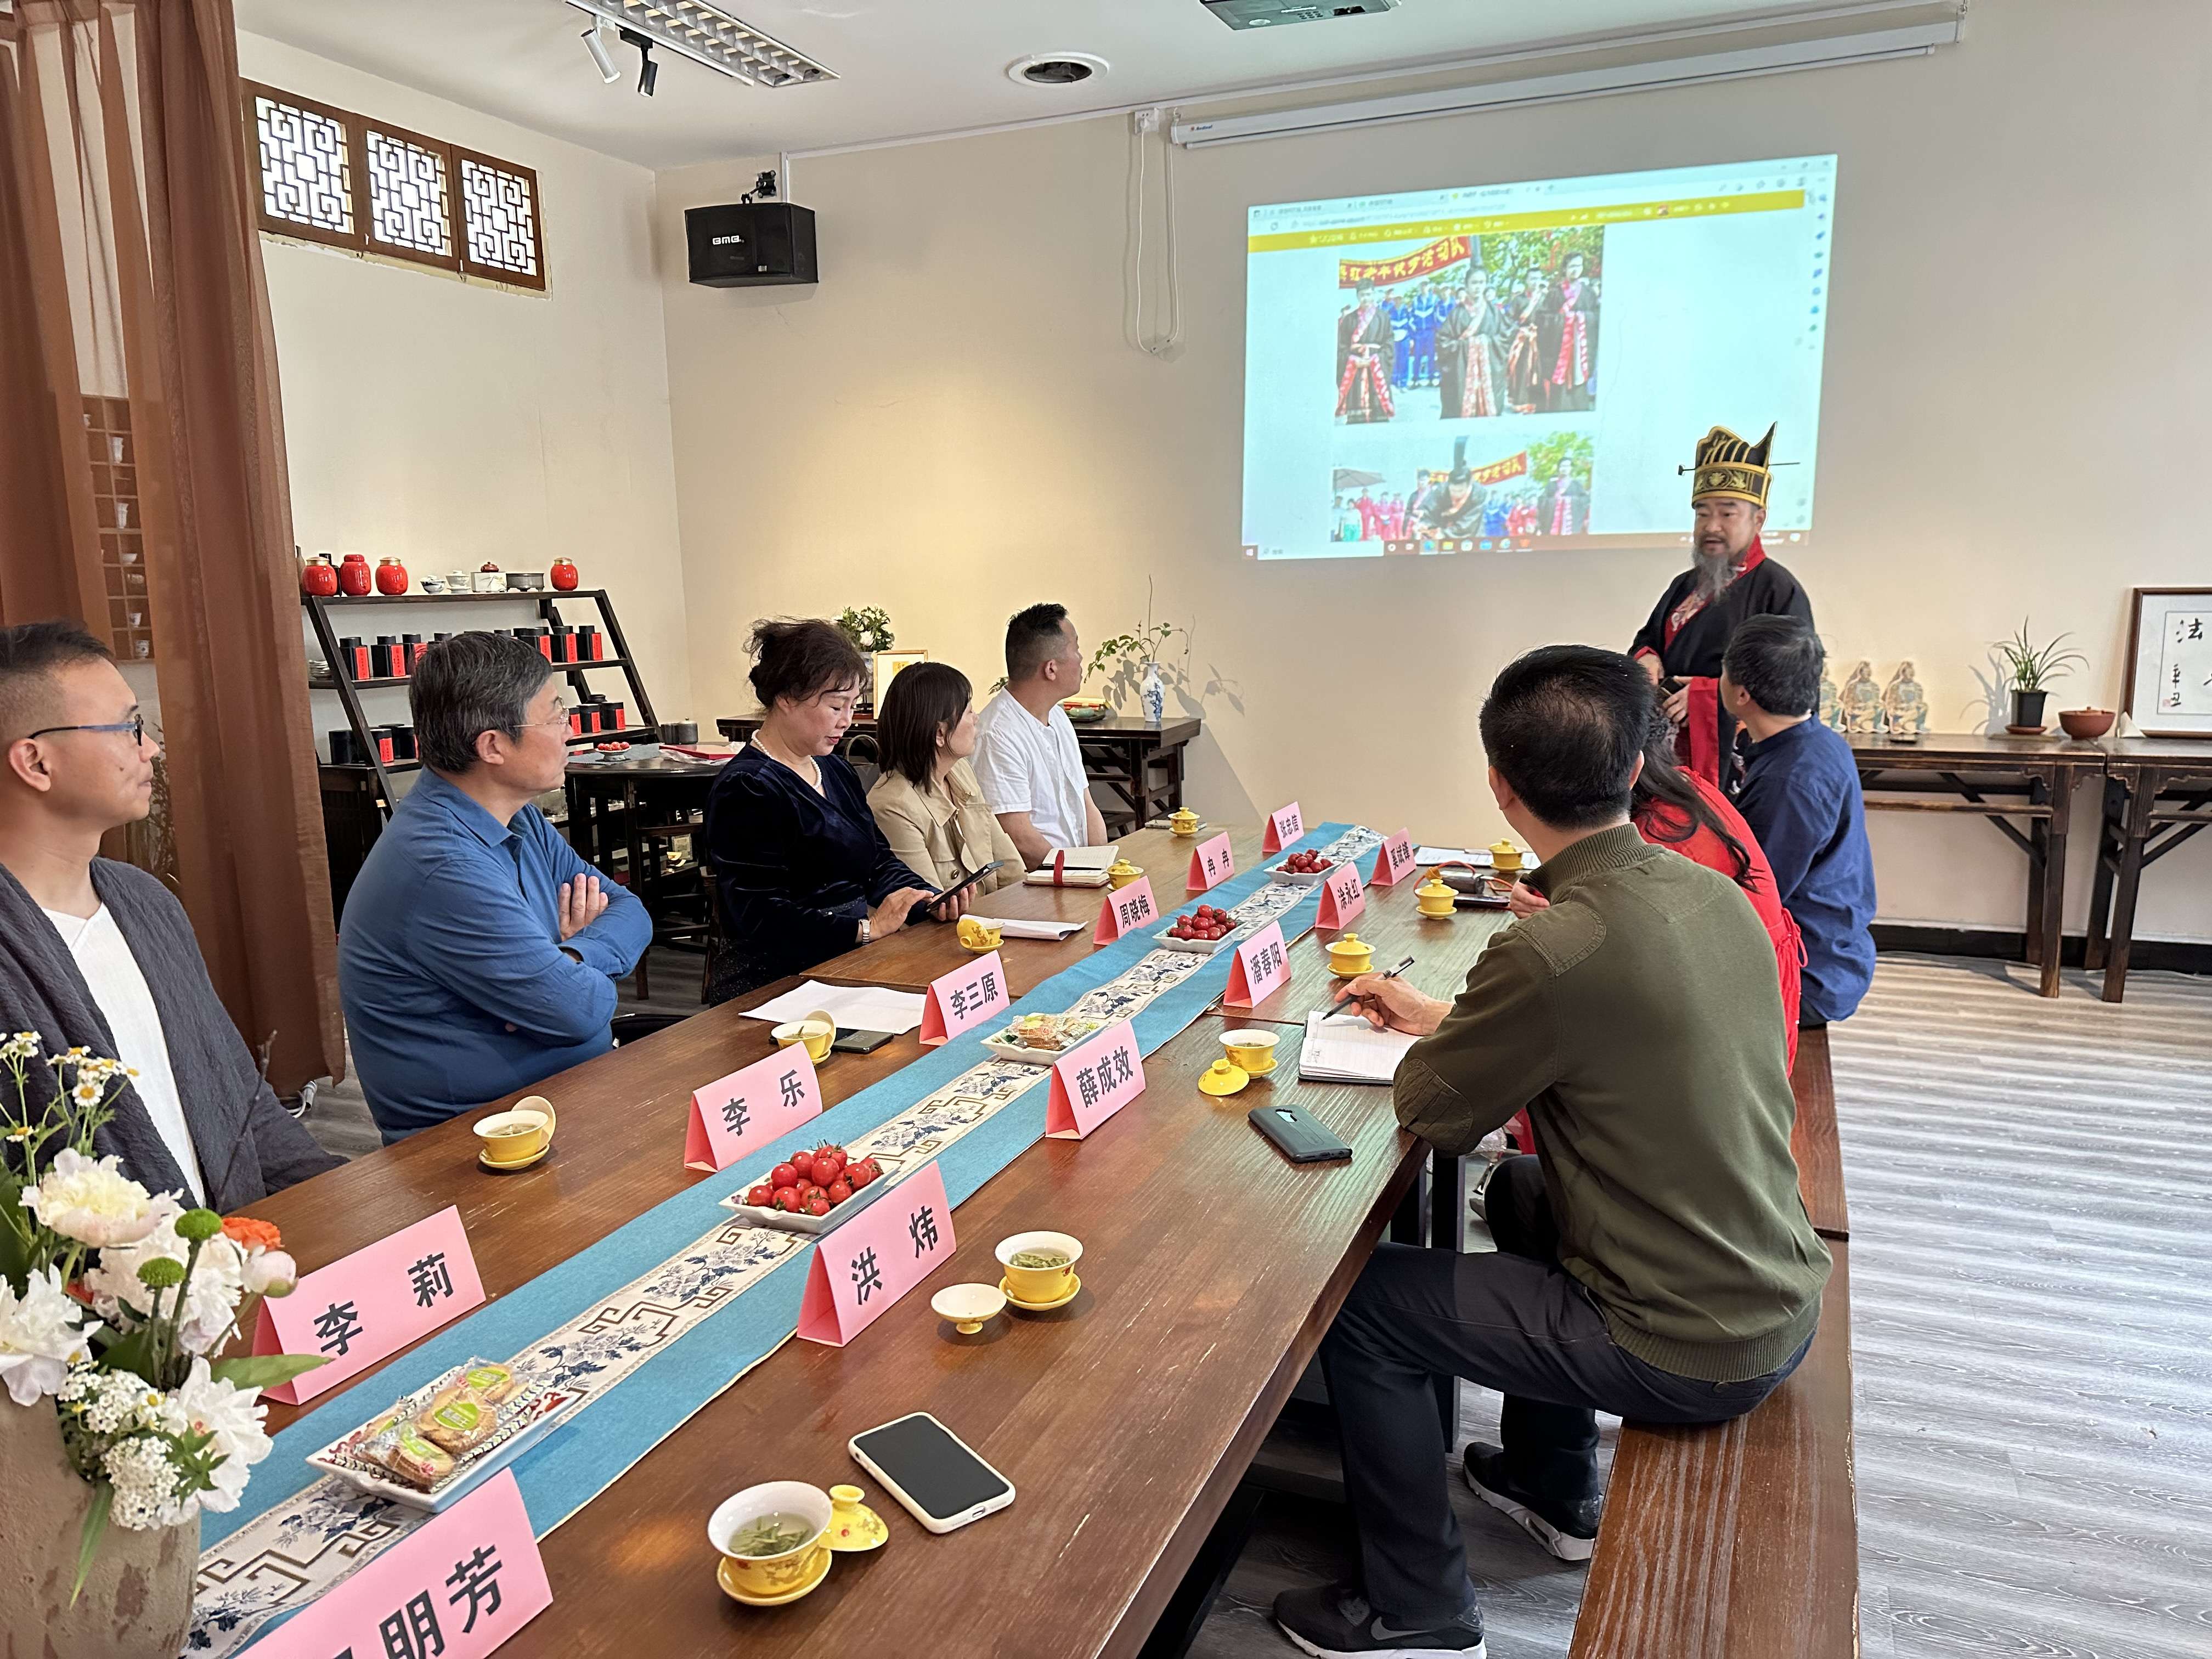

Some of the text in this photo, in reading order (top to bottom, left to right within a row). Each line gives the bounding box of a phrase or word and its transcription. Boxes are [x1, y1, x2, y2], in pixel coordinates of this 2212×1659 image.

[2176, 618, 2203, 643] 法
[1279, 814, 1299, 838] 张忠信
[1120, 894, 1150, 928] 周晓梅
[1338, 878, 1360, 910] 涂永红
[1250, 941, 1282, 984] 潘春阳
[950, 972, 998, 1020] 李三原
[1076, 1046, 1133, 1108] 薛成效
[331, 1544, 503, 1659] 明芳
